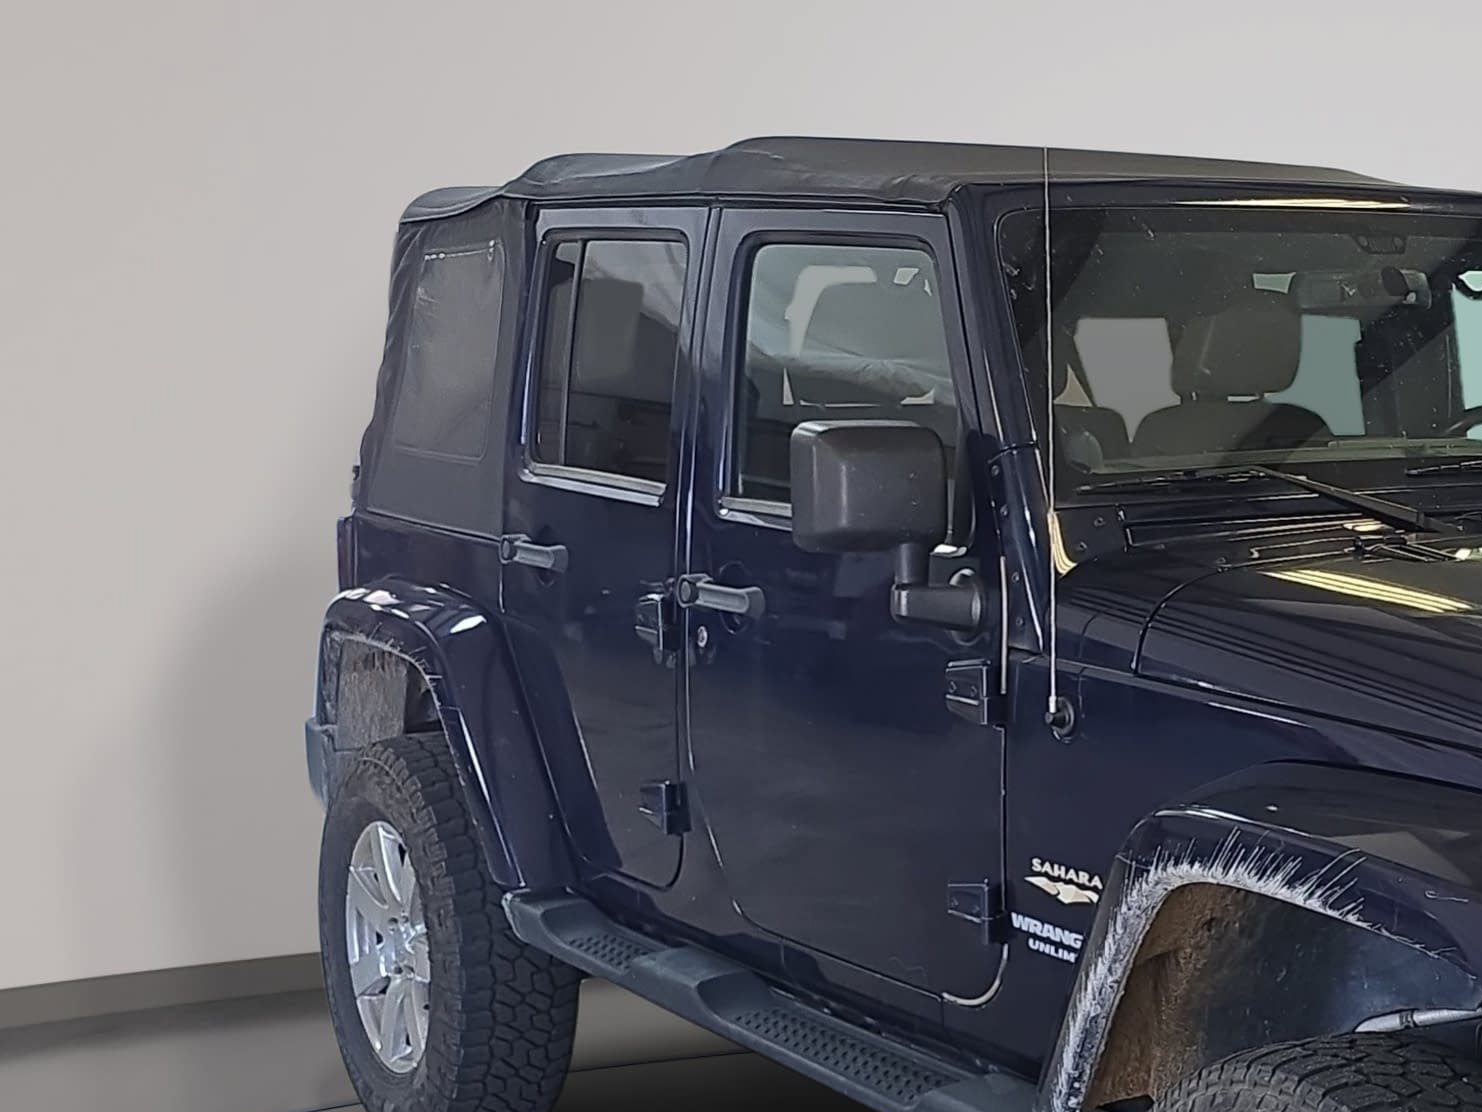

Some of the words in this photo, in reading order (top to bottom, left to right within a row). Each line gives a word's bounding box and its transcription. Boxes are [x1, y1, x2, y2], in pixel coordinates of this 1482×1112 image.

[1031, 857, 1103, 890] SAHARA
[1011, 911, 1084, 949] WRANG
[1028, 937, 1079, 963] UNLIM
